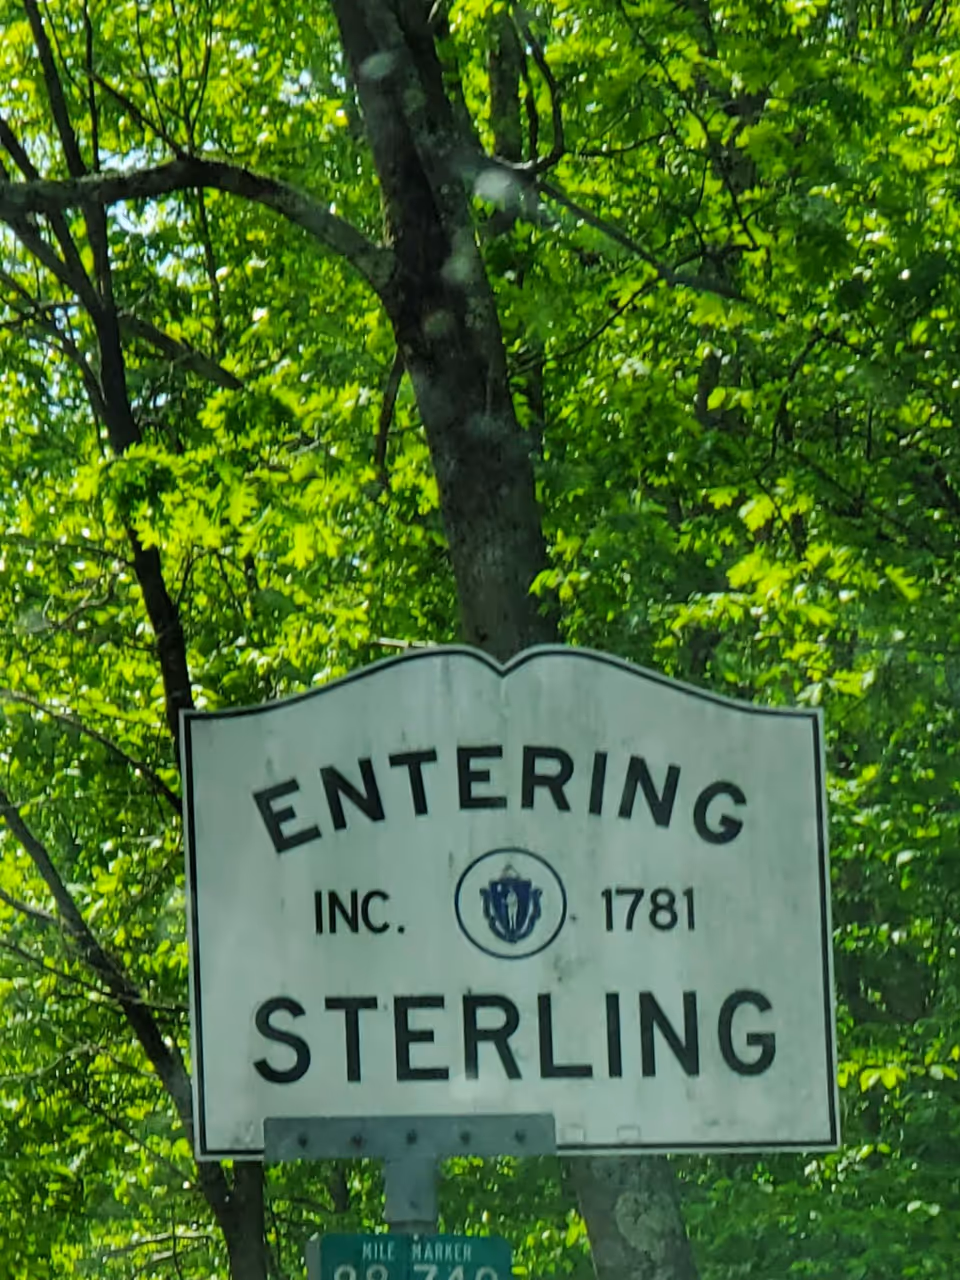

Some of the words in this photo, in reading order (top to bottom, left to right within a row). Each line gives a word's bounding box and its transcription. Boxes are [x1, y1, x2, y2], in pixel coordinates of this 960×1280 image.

[253, 744, 748, 854] ENTERING
[314, 890, 405, 935] INC.
[601, 887, 695, 931] 1781
[253, 988, 777, 1084] STERLING
[362, 1241, 395, 1261] MILE
[412, 1242, 472, 1262] MARKER
